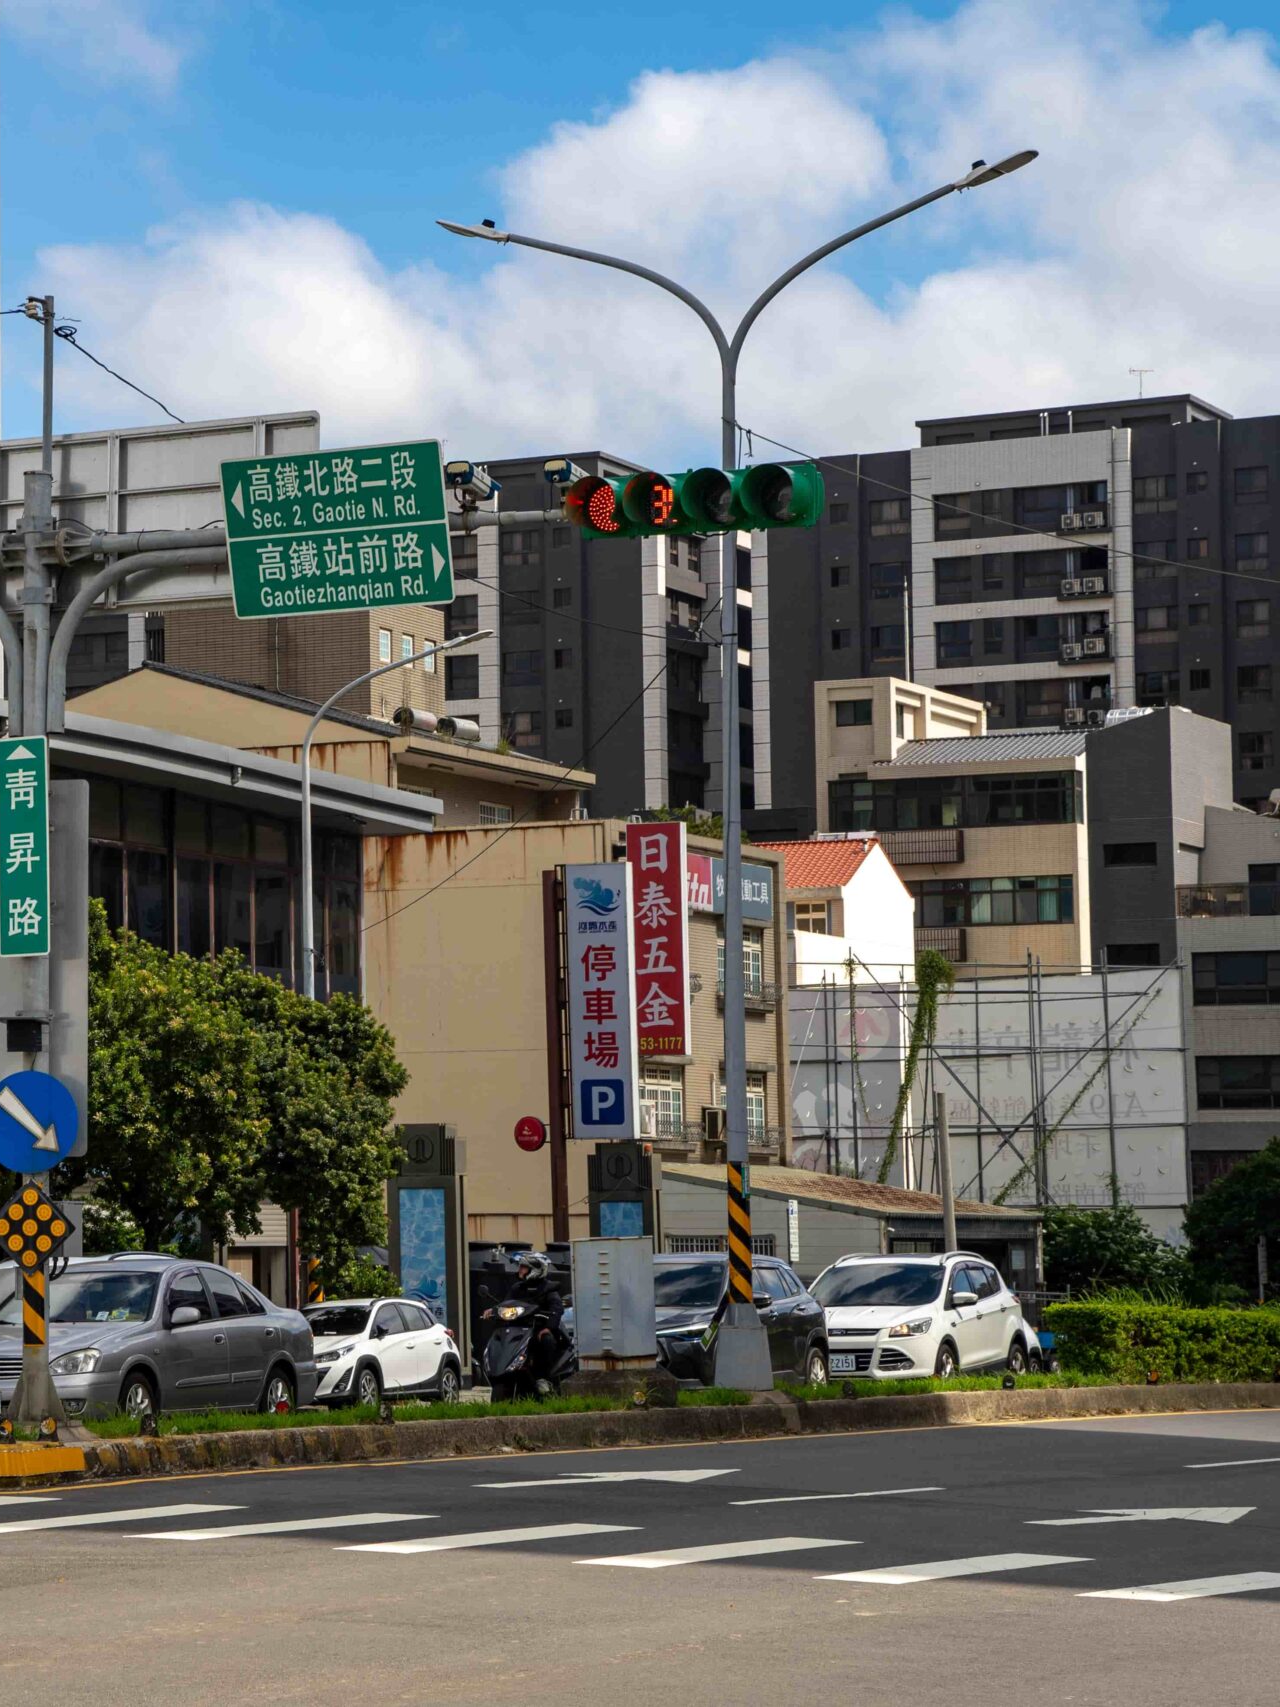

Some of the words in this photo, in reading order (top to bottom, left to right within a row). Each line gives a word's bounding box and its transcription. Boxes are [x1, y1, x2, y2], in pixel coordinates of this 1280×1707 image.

[247, 451, 417, 505] 高鐵北路二段
[252, 508, 287, 529] Sec.
[292, 505, 307, 527] 2,
[312, 502, 366, 524] Gaotie
[372, 497, 388, 518] N.
[394, 494, 421, 516] Rd.
[256, 532, 424, 583] 高鐵站前路
[260, 581, 394, 608] Gaotiezhanqian
[401, 575, 429, 597] Rd.
[4, 768, 42, 936] 青昇路
[634, 832, 680, 1029] 日泰五金
[580, 943, 619, 1069] 停車場
[591, 1085, 616, 1121] P
